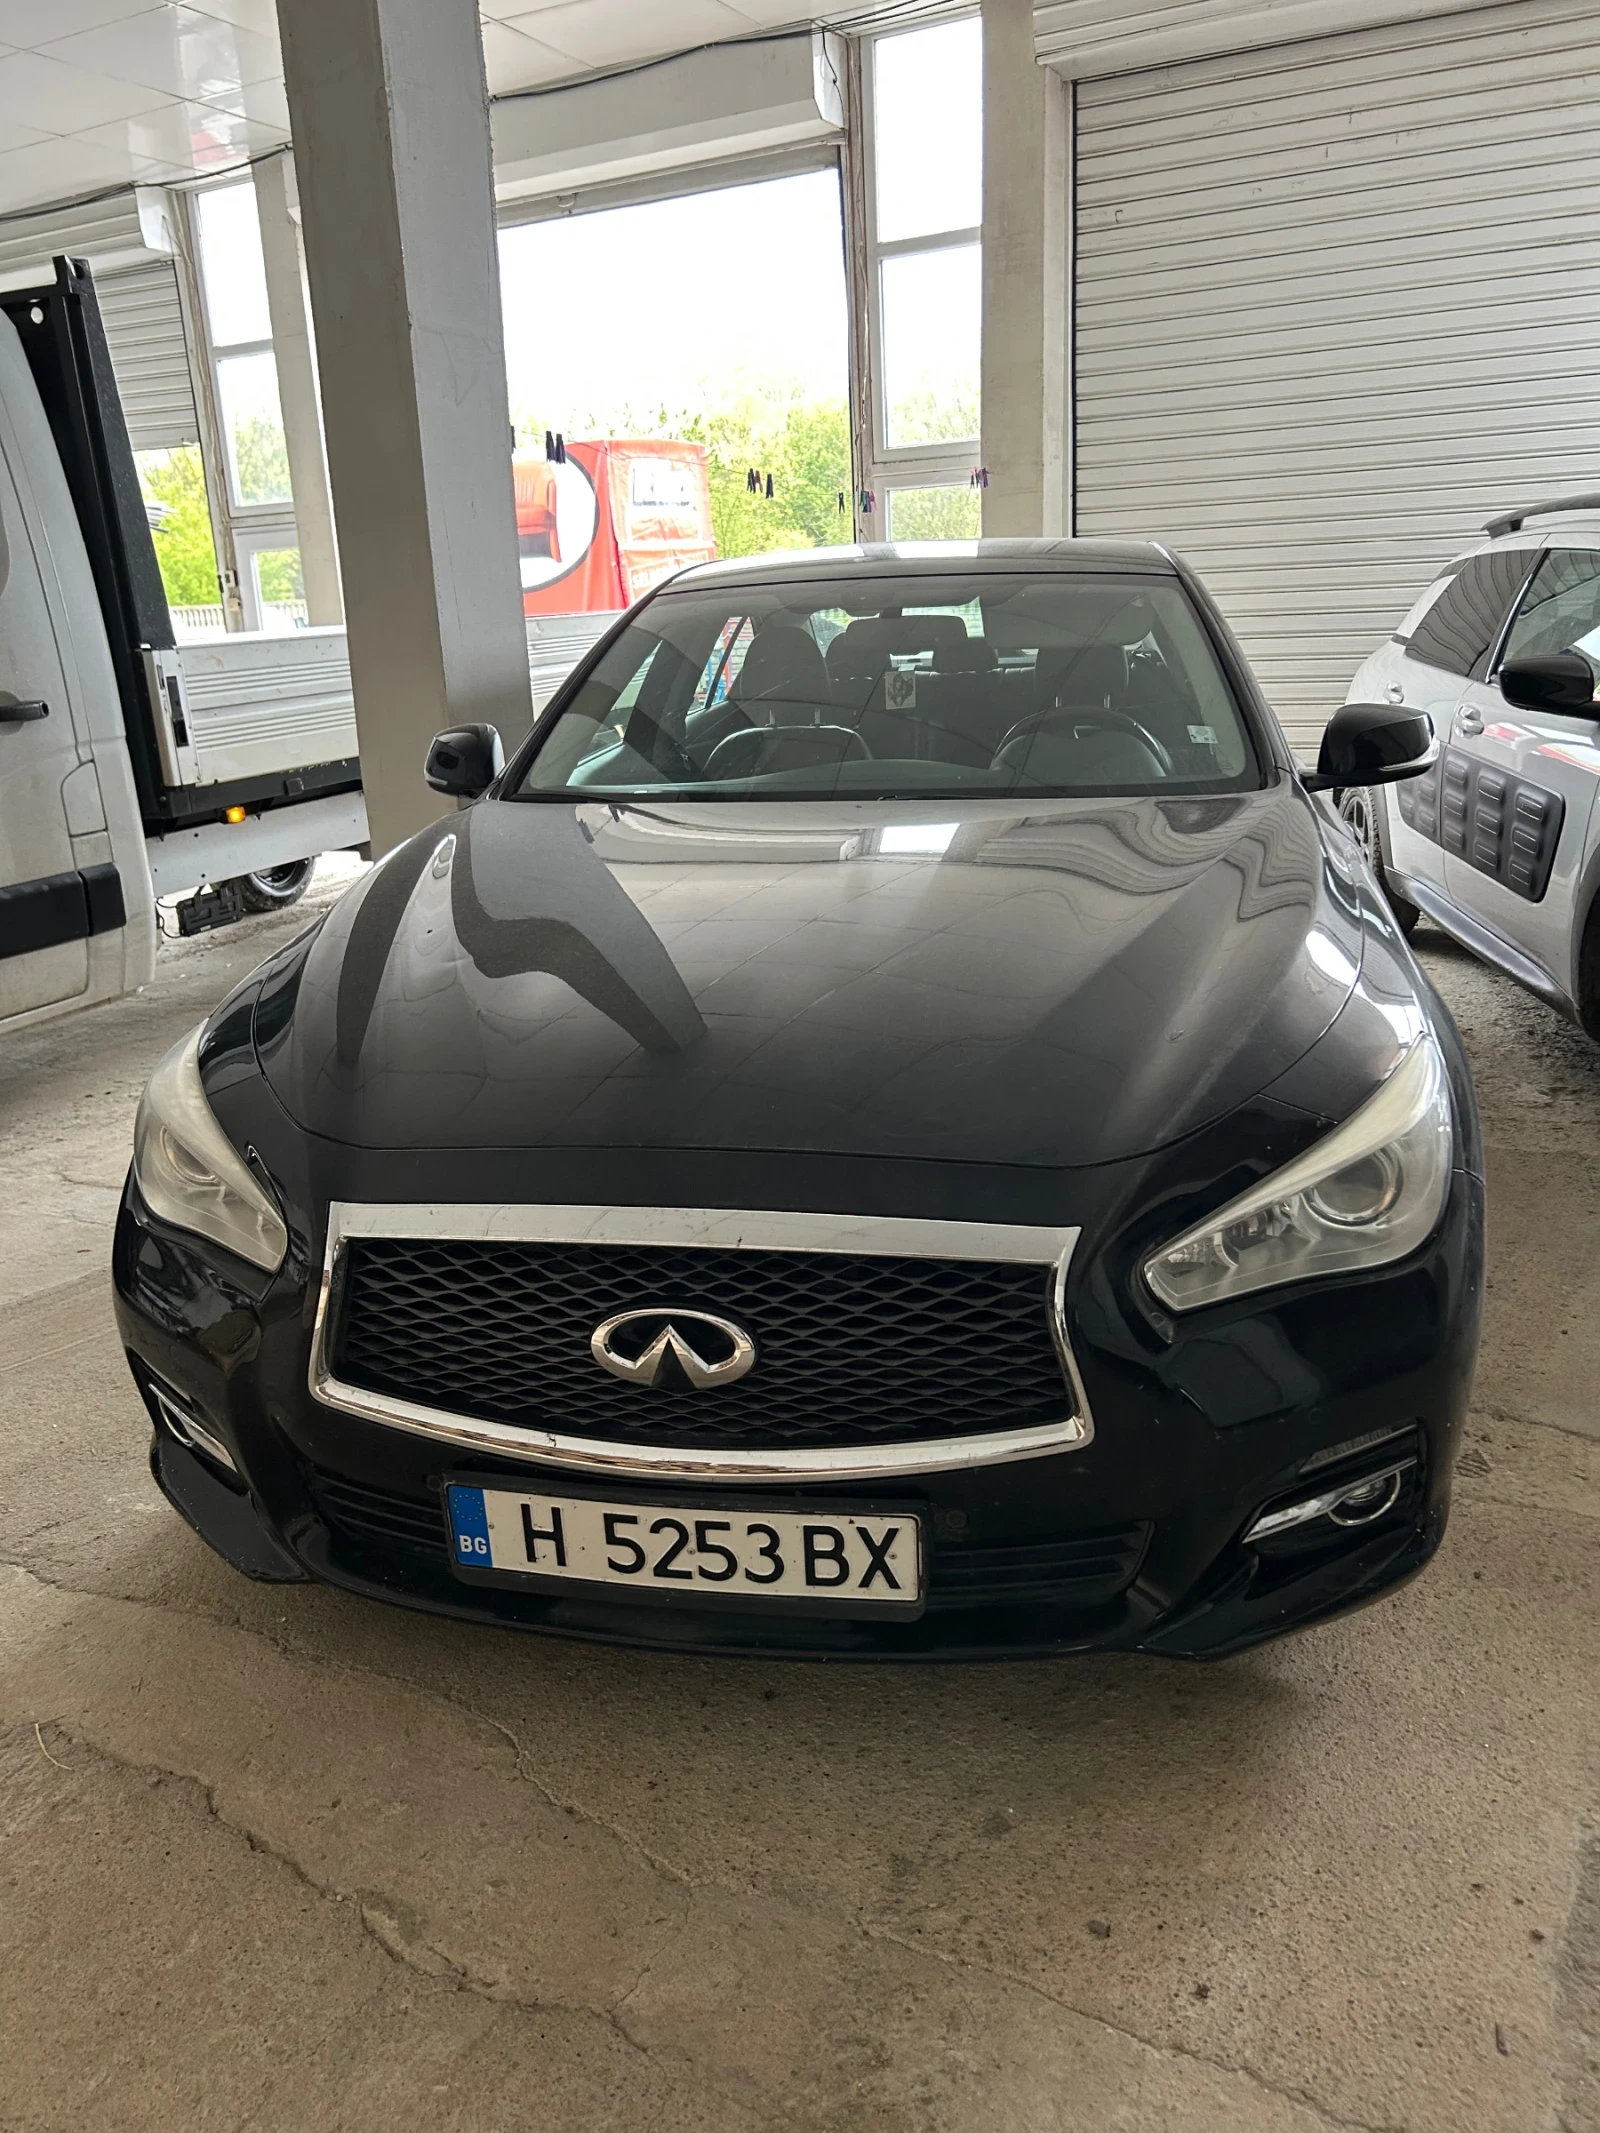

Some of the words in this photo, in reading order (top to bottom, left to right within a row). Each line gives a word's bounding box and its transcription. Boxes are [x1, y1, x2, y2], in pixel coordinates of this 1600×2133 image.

[459, 1534, 488, 1555] BG
[520, 1503, 567, 1567] H
[602, 1512, 785, 1585] 5253
[803, 1524, 902, 1590] BX
